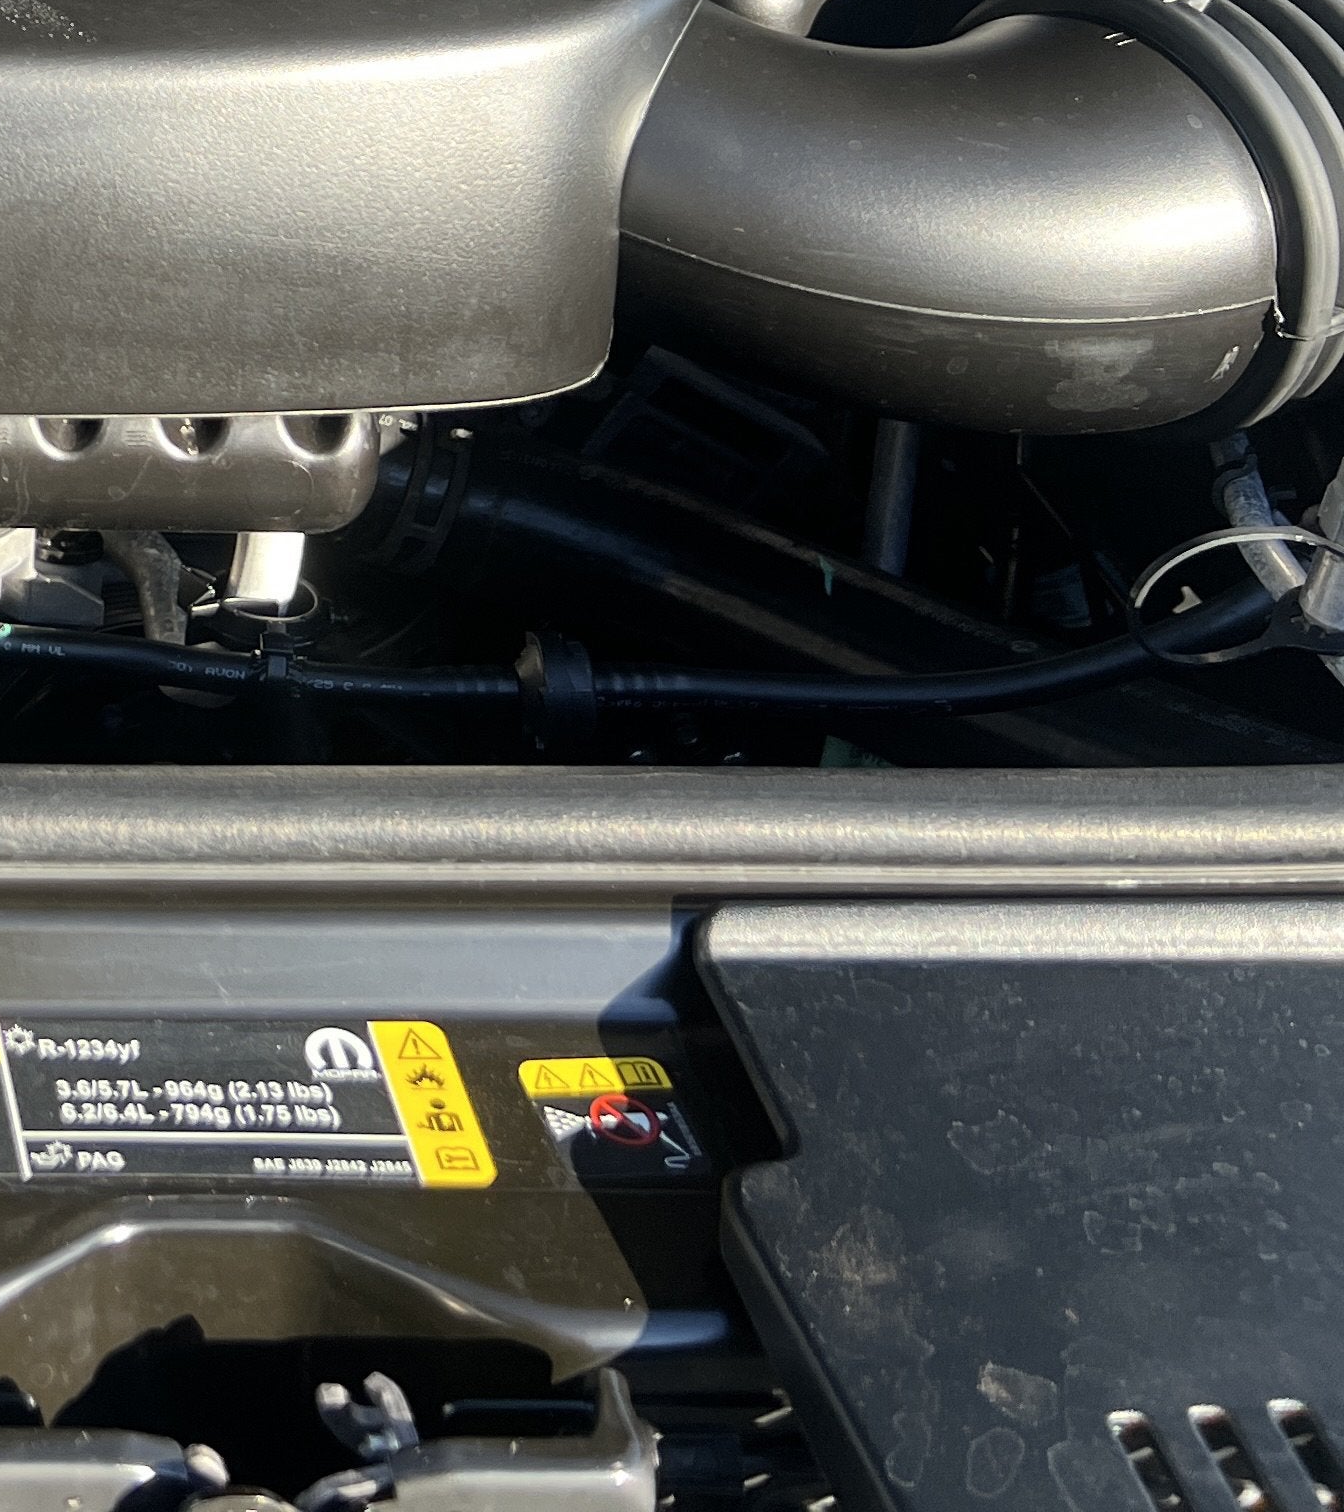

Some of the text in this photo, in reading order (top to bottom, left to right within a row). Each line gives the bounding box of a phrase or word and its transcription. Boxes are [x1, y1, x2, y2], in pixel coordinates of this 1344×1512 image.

[37, 1038, 141, 1065] R-1234yf
[55, 1078, 149, 1102] 3.6/5.7L
[164, 1080, 223, 1106] 964g
[227, 1080, 284, 1105] (2.13
[286, 1080, 334, 1106] lbs)
[60, 1102, 154, 1127] 6.2/6.4L
[171, 1104, 231, 1129] 794g
[235, 1103, 292, 1130] (1.75
[293, 1104, 343, 1132] lbs)
[76, 1150, 127, 1173] PAG
